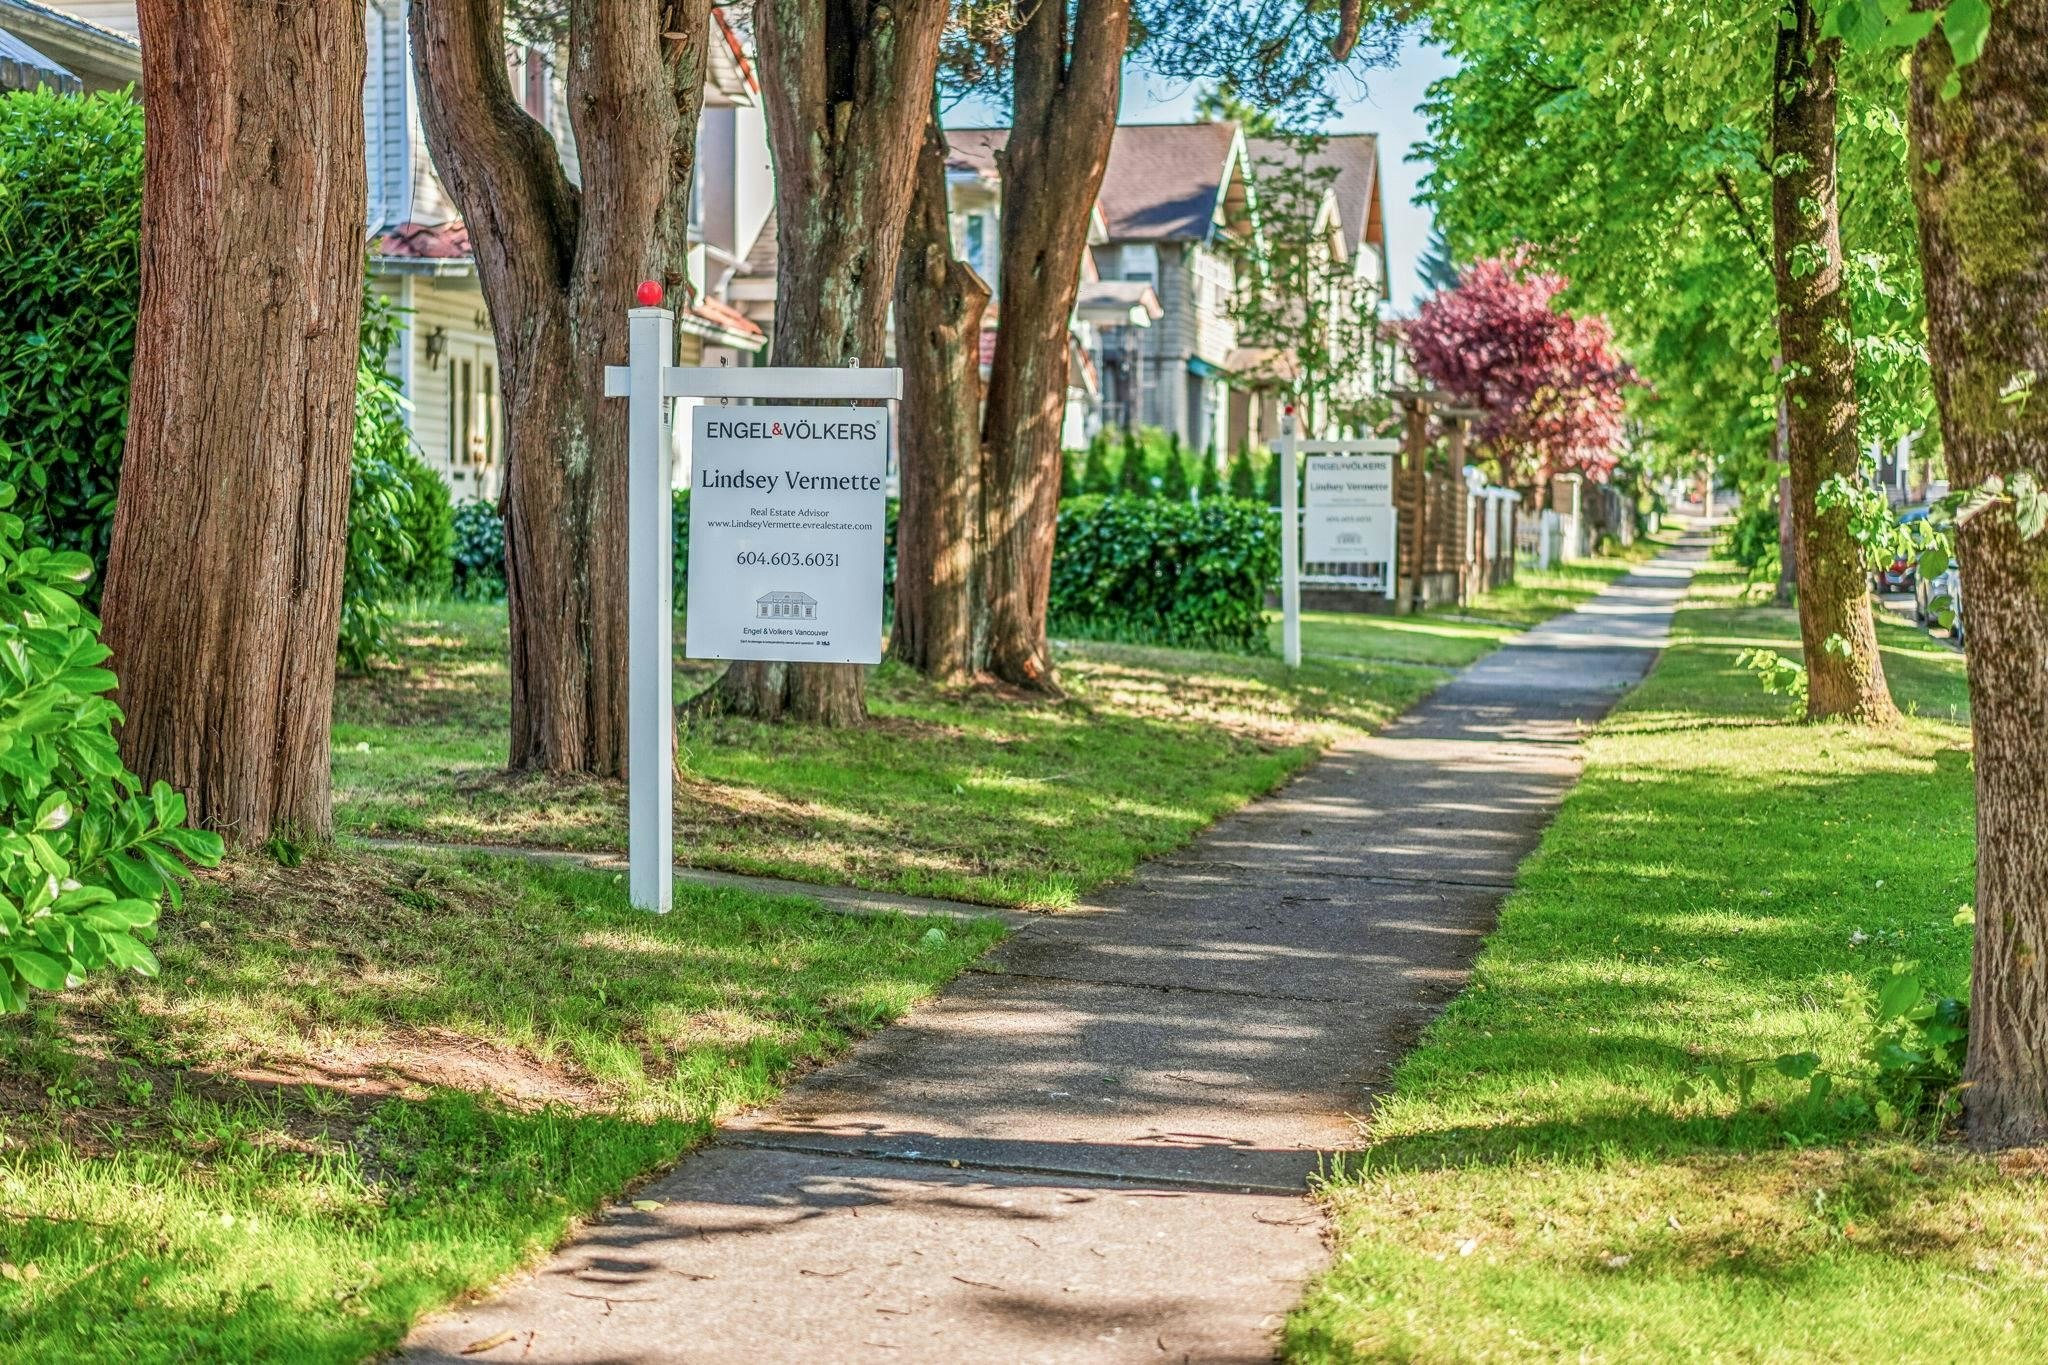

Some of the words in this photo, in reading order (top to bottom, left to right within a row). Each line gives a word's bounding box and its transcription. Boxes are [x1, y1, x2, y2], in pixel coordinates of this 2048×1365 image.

[702, 469, 779, 494] Lindsey
[785, 471, 881, 491] Vermette
[750, 508, 768, 517] Real
[769, 508, 796, 517] Estate
[797, 508, 830, 518] Advisor
[707, 519, 872, 530] www.LindseyVermette.evrealestate.com
[736, 551, 840, 567] 604.603.6031
[743, 627, 763, 637] Engel
[794, 629, 829, 637] Vancouver
